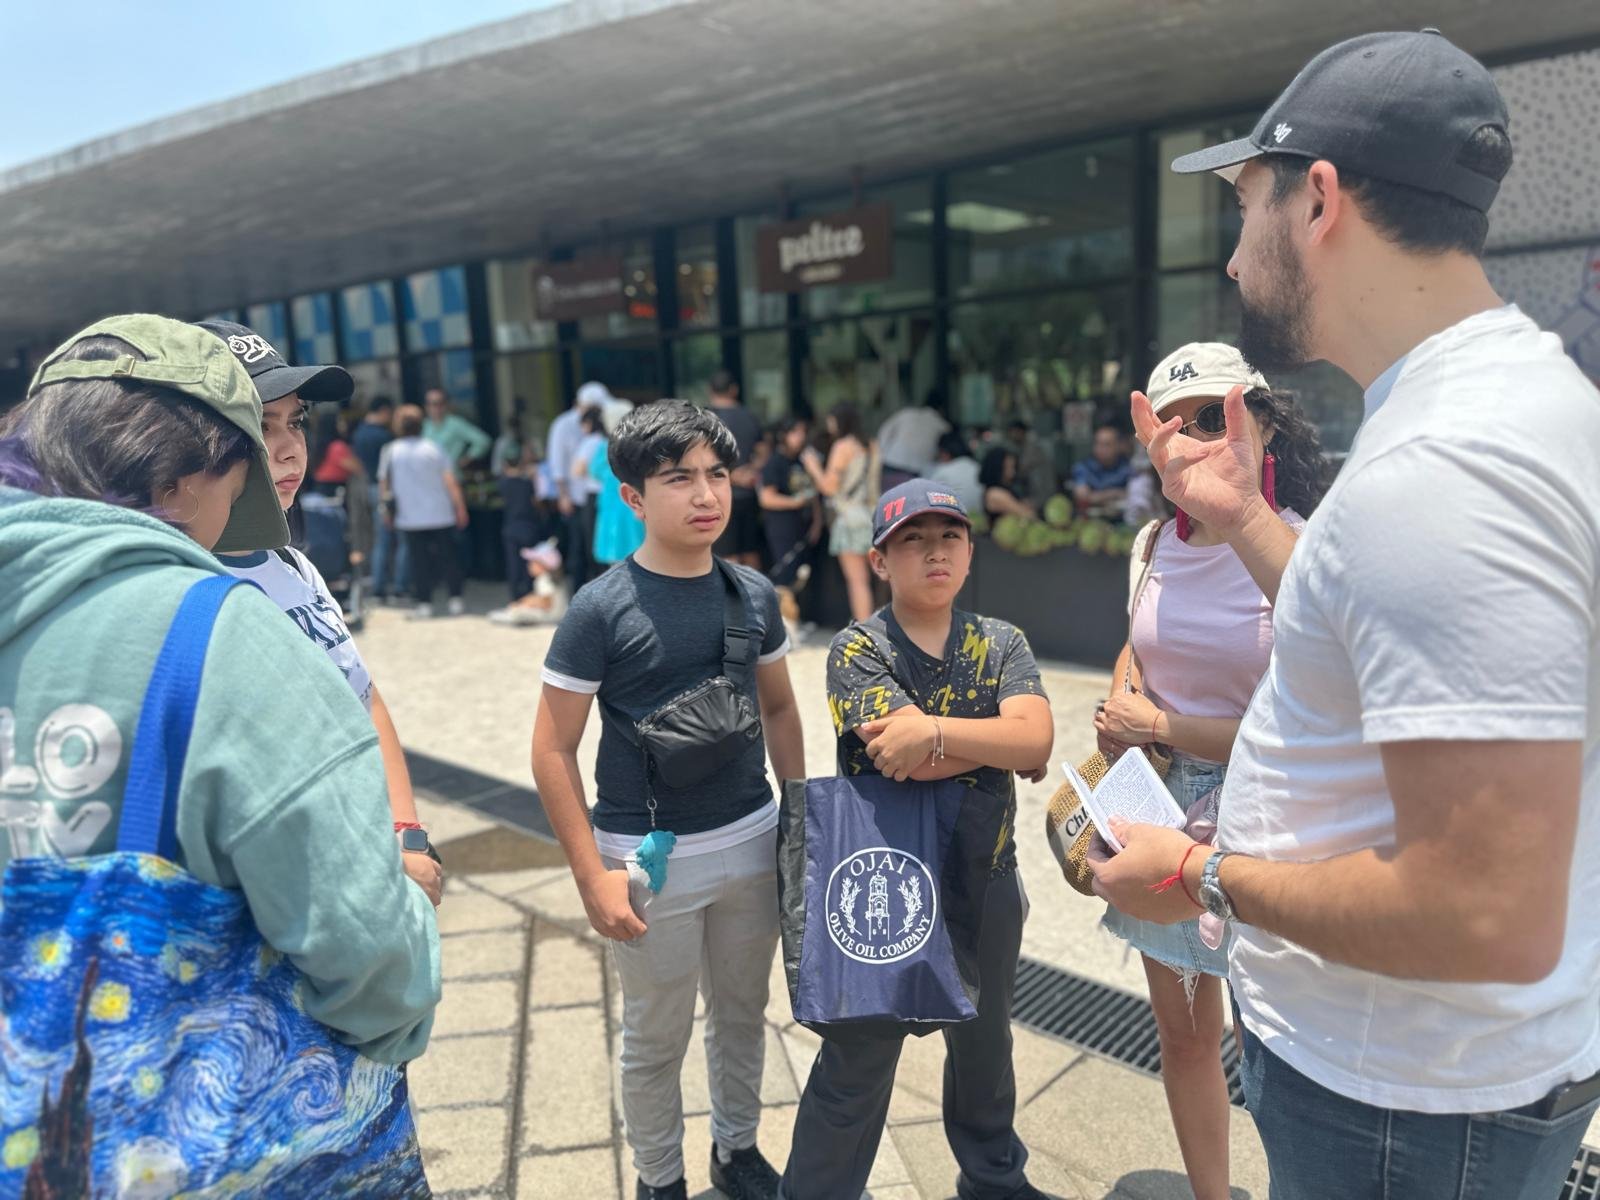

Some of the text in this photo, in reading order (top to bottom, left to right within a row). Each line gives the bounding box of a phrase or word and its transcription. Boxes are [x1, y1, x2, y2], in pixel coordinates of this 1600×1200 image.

[1169, 362, 1199, 381] LA
[1066, 806, 1089, 837] Chl
[850, 853, 908, 876] OJAI
[829, 912, 931, 958] OLIVE OIL COMPANY
